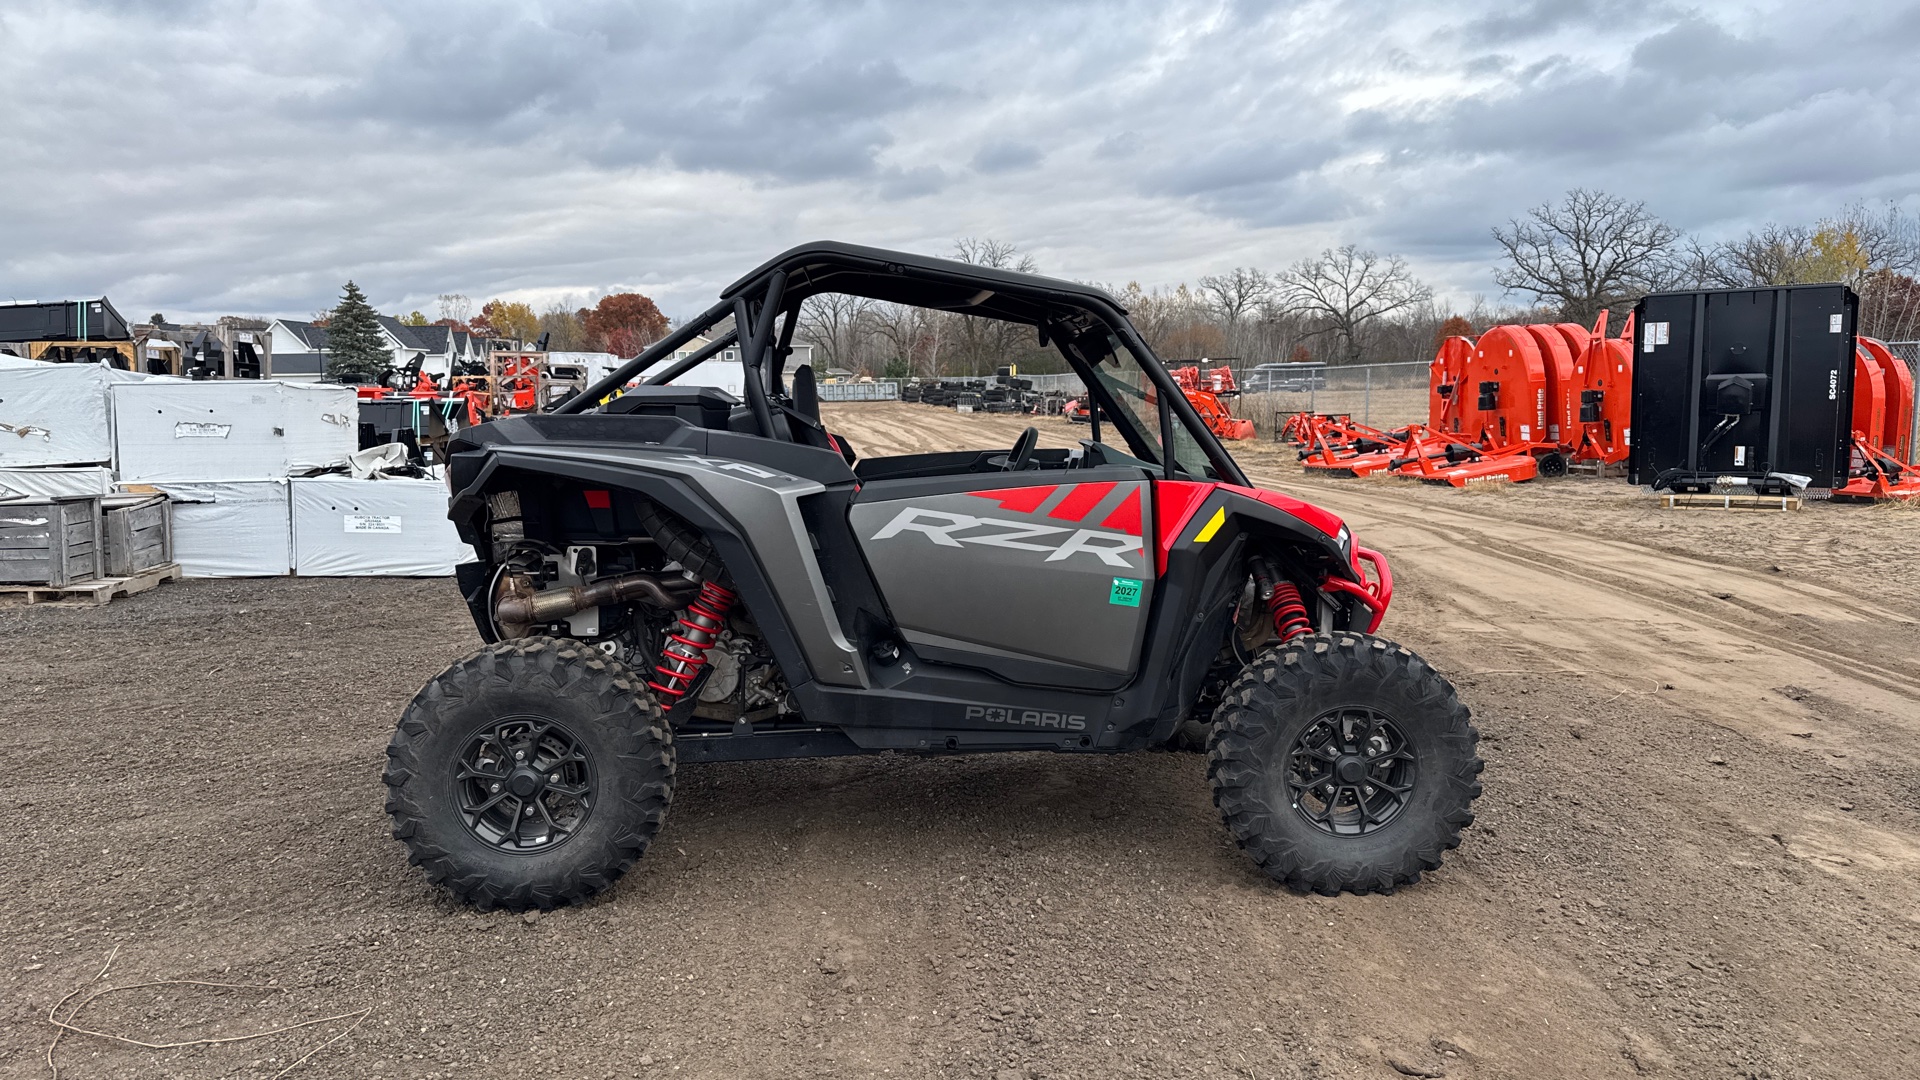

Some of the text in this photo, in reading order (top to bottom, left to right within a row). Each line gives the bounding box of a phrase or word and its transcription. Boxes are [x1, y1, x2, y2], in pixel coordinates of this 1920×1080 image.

[1829, 369, 1838, 400] SC4072
[1536, 388, 1544, 430] Land Pride
[870, 507, 1143, 568] RZR
[1115, 586, 1138, 596] 2027
[965, 705, 1086, 731] POLARIS
